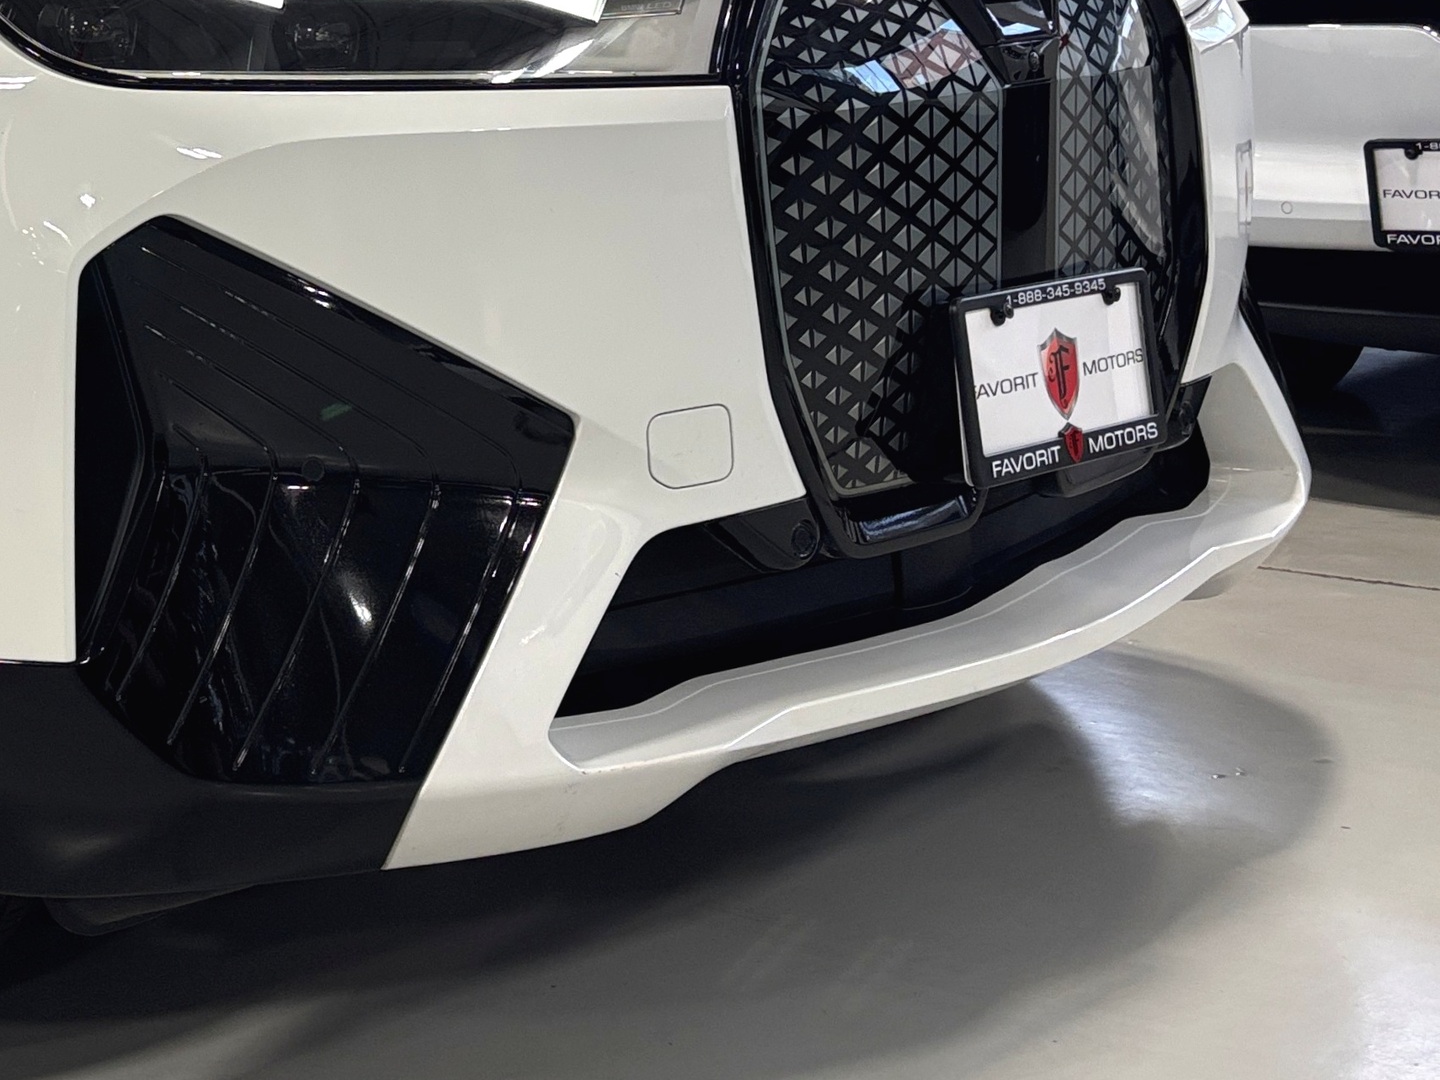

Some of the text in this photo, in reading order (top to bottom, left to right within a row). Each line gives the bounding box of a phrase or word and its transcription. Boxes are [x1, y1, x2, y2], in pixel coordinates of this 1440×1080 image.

[1006, 278, 1106, 306] 1-888-345-9345
[1082, 347, 1144, 376] MOTORS
[991, 445, 1061, 479] FAVORIT
[1088, 421, 1159, 454] MOTORS
